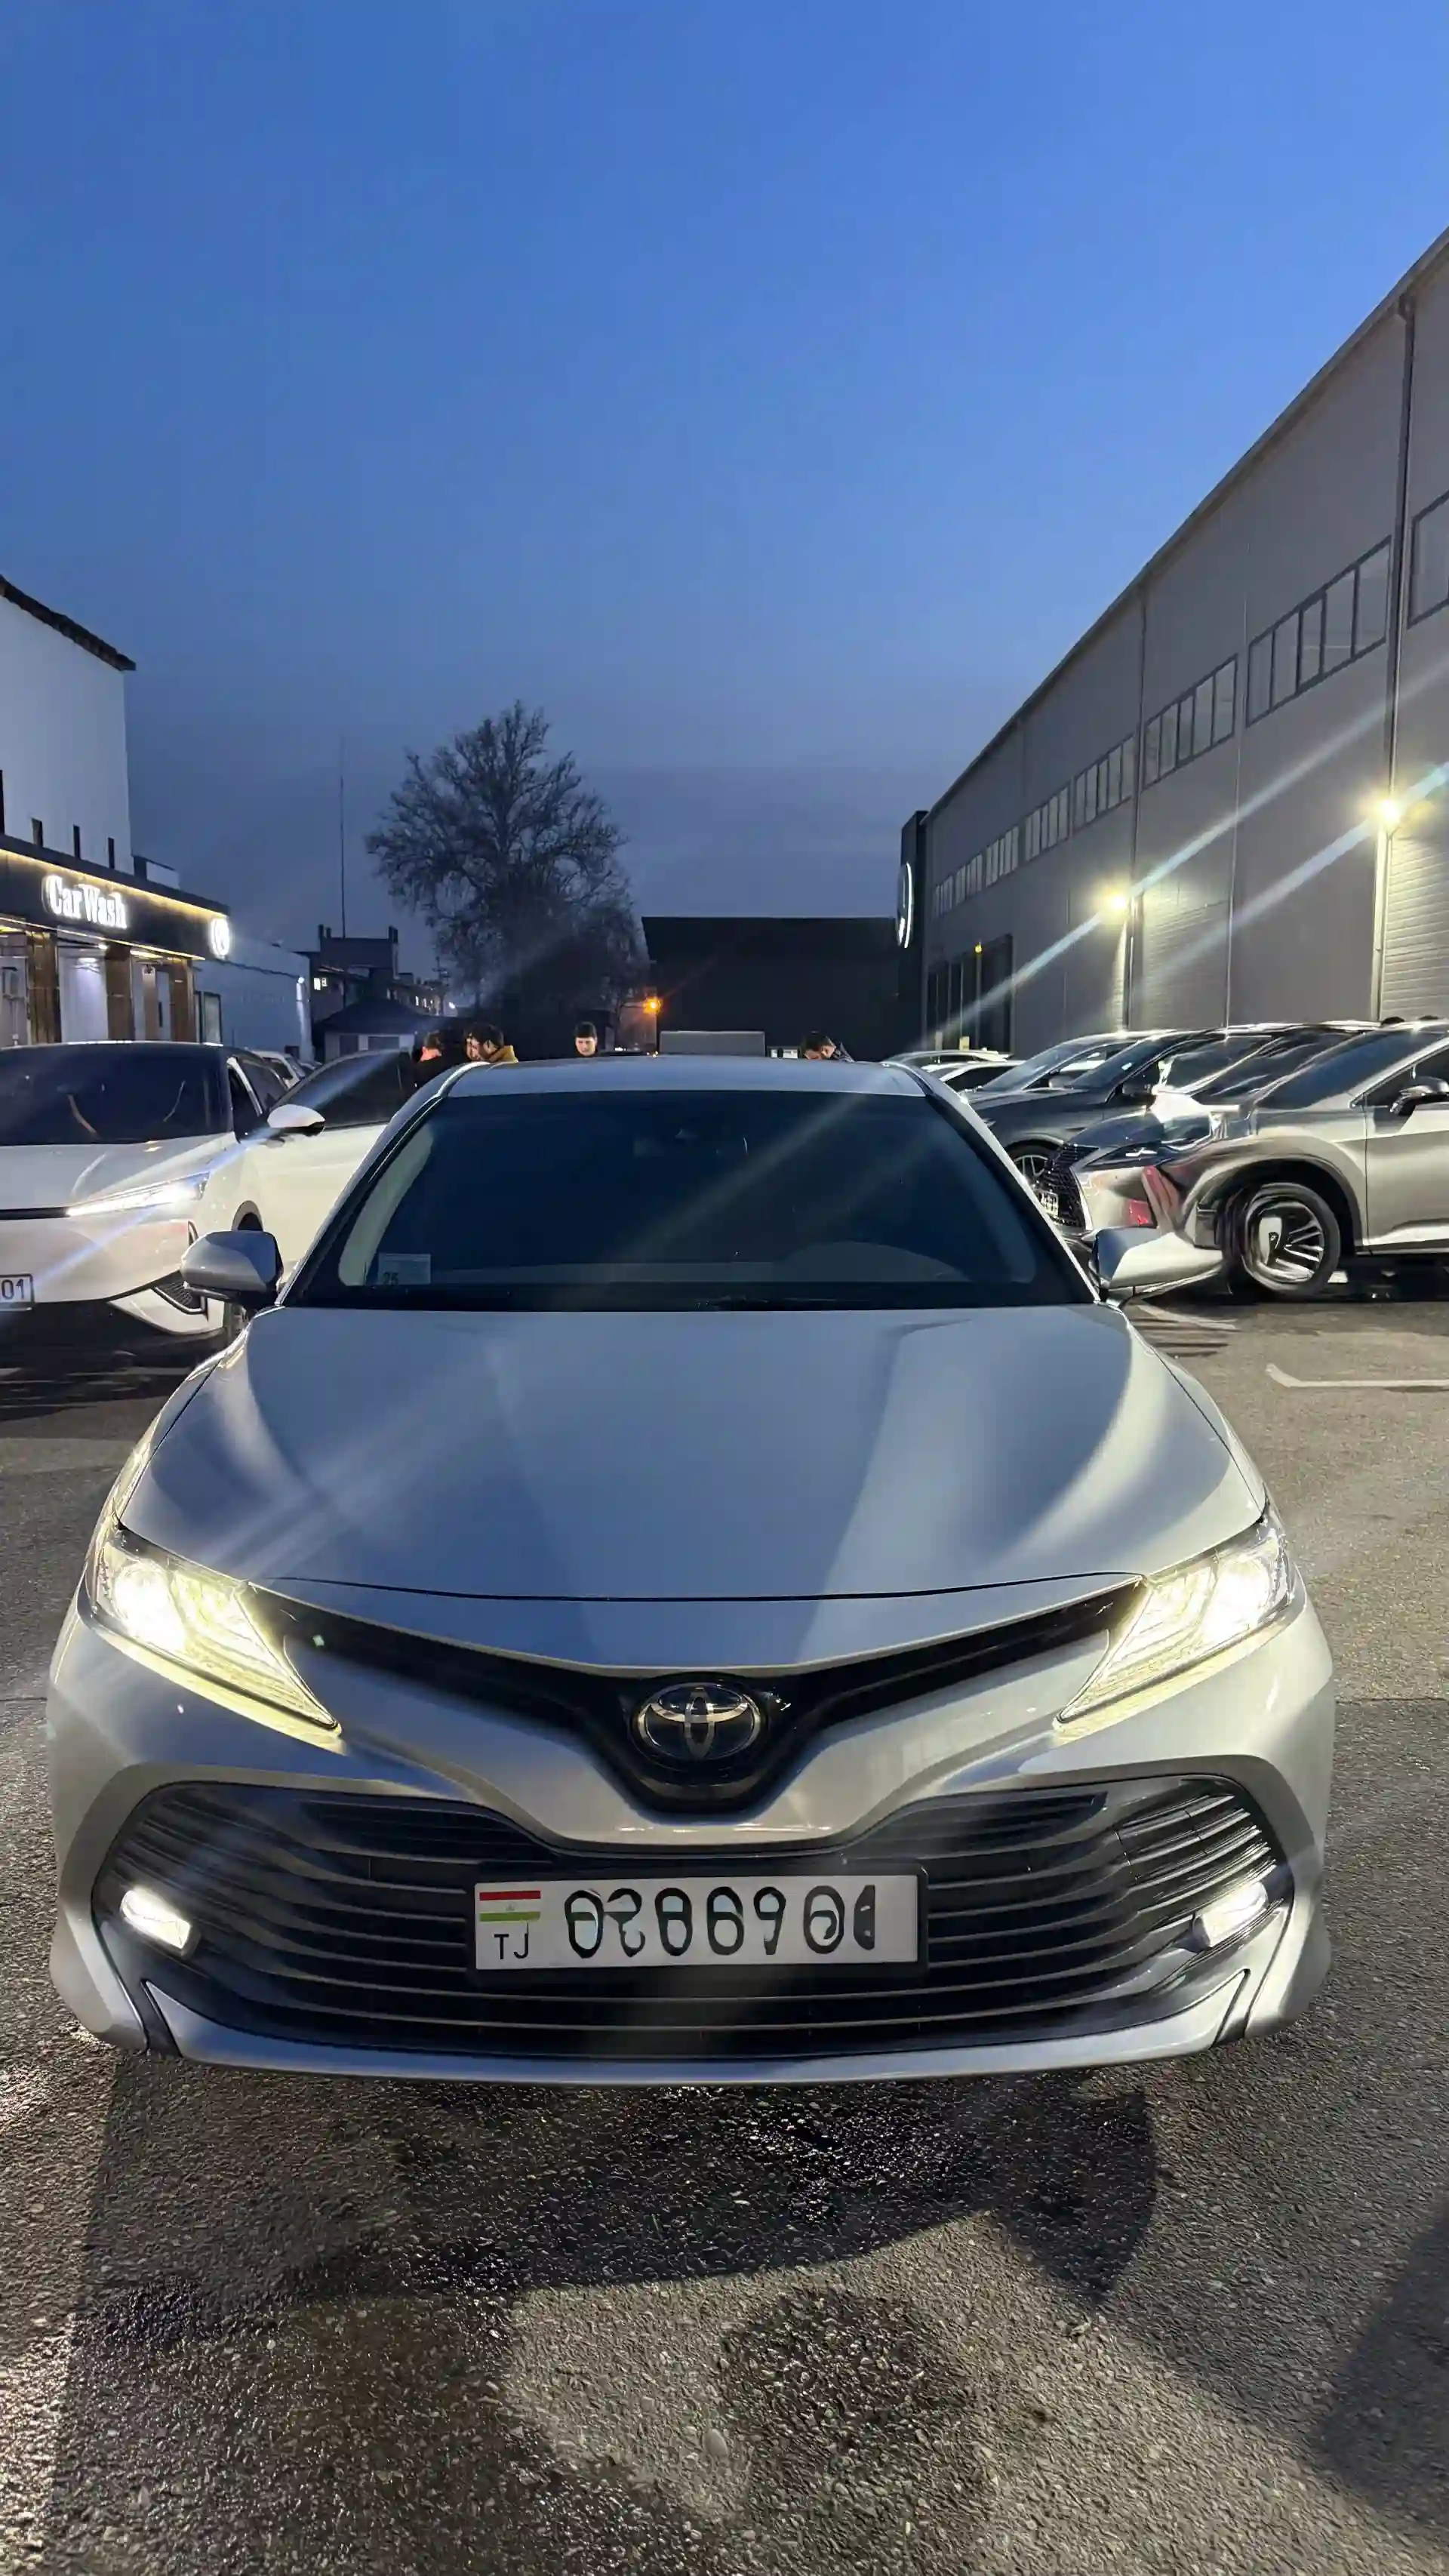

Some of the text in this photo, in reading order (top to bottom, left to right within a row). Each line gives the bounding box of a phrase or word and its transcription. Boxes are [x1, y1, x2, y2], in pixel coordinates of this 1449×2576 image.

[44, 875, 127, 928] Car Wash
[2, 1279, 24, 1300] 01
[494, 1932, 529, 1960] TJ
